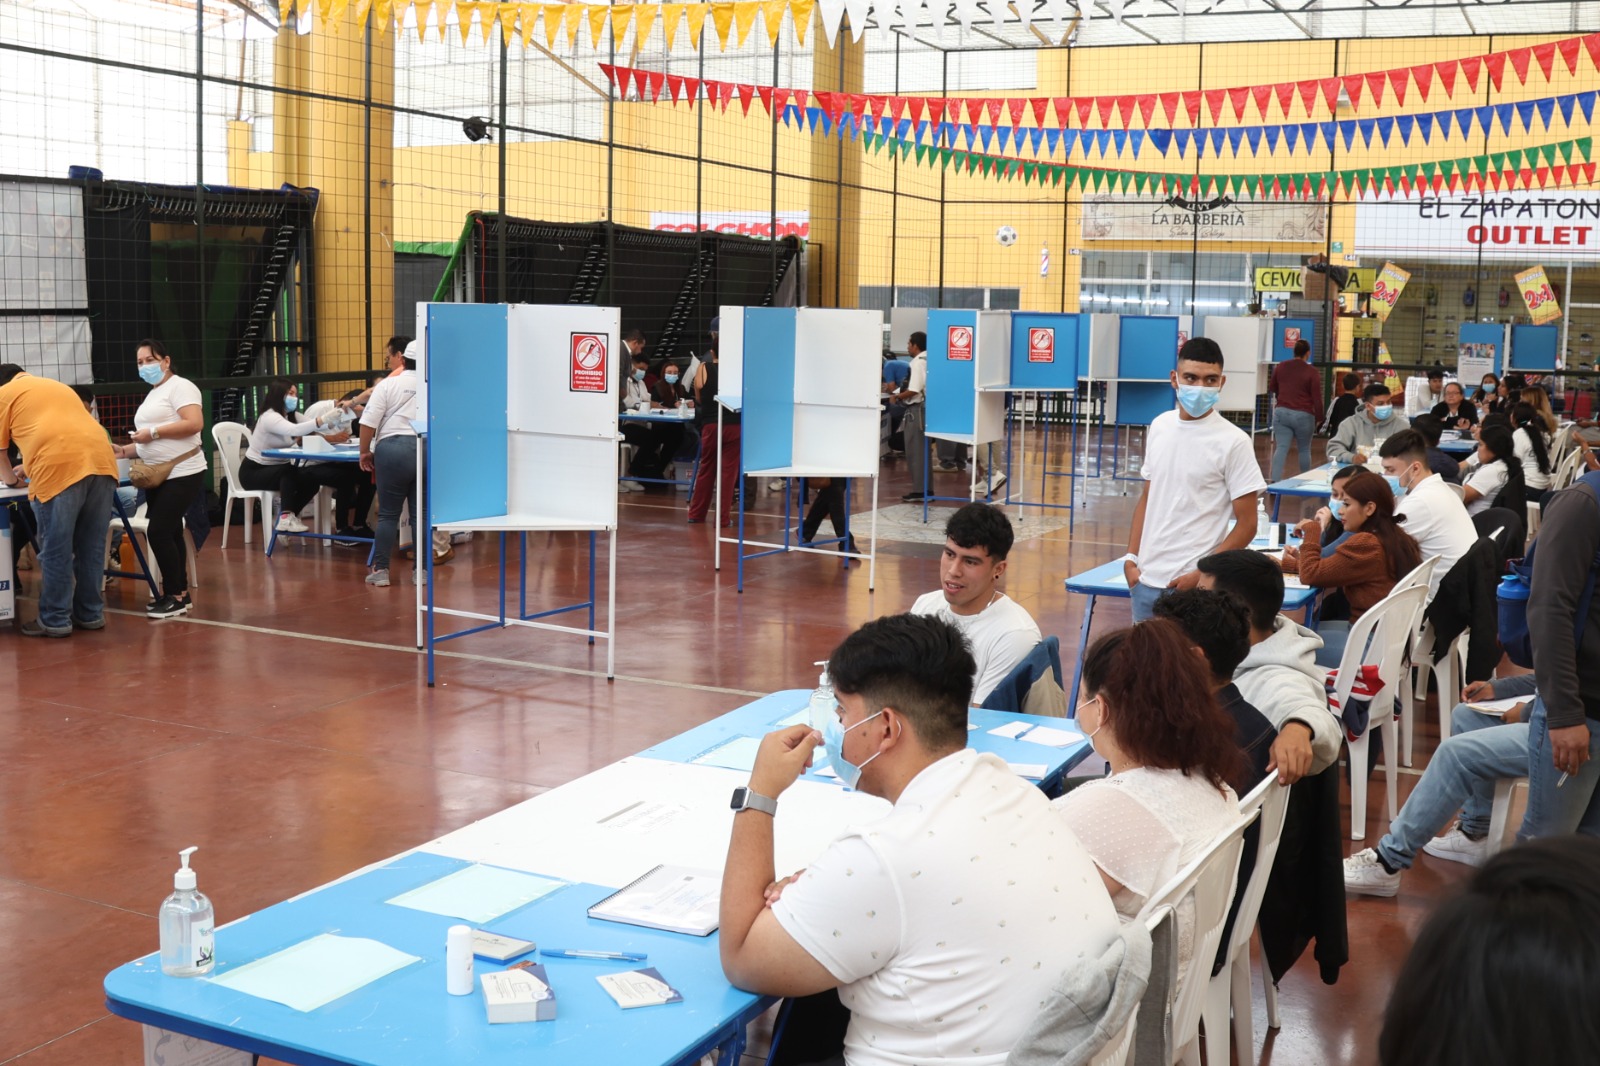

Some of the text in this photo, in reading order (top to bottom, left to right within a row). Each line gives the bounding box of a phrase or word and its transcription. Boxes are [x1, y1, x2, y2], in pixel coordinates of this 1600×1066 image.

[1151, 213, 1169, 225] LA
[1419, 197, 1450, 219] EL
[1467, 225, 1593, 245] OUTLET
[1371, 280, 1399, 307] 2x1
[1524, 283, 1554, 309] 2x1
